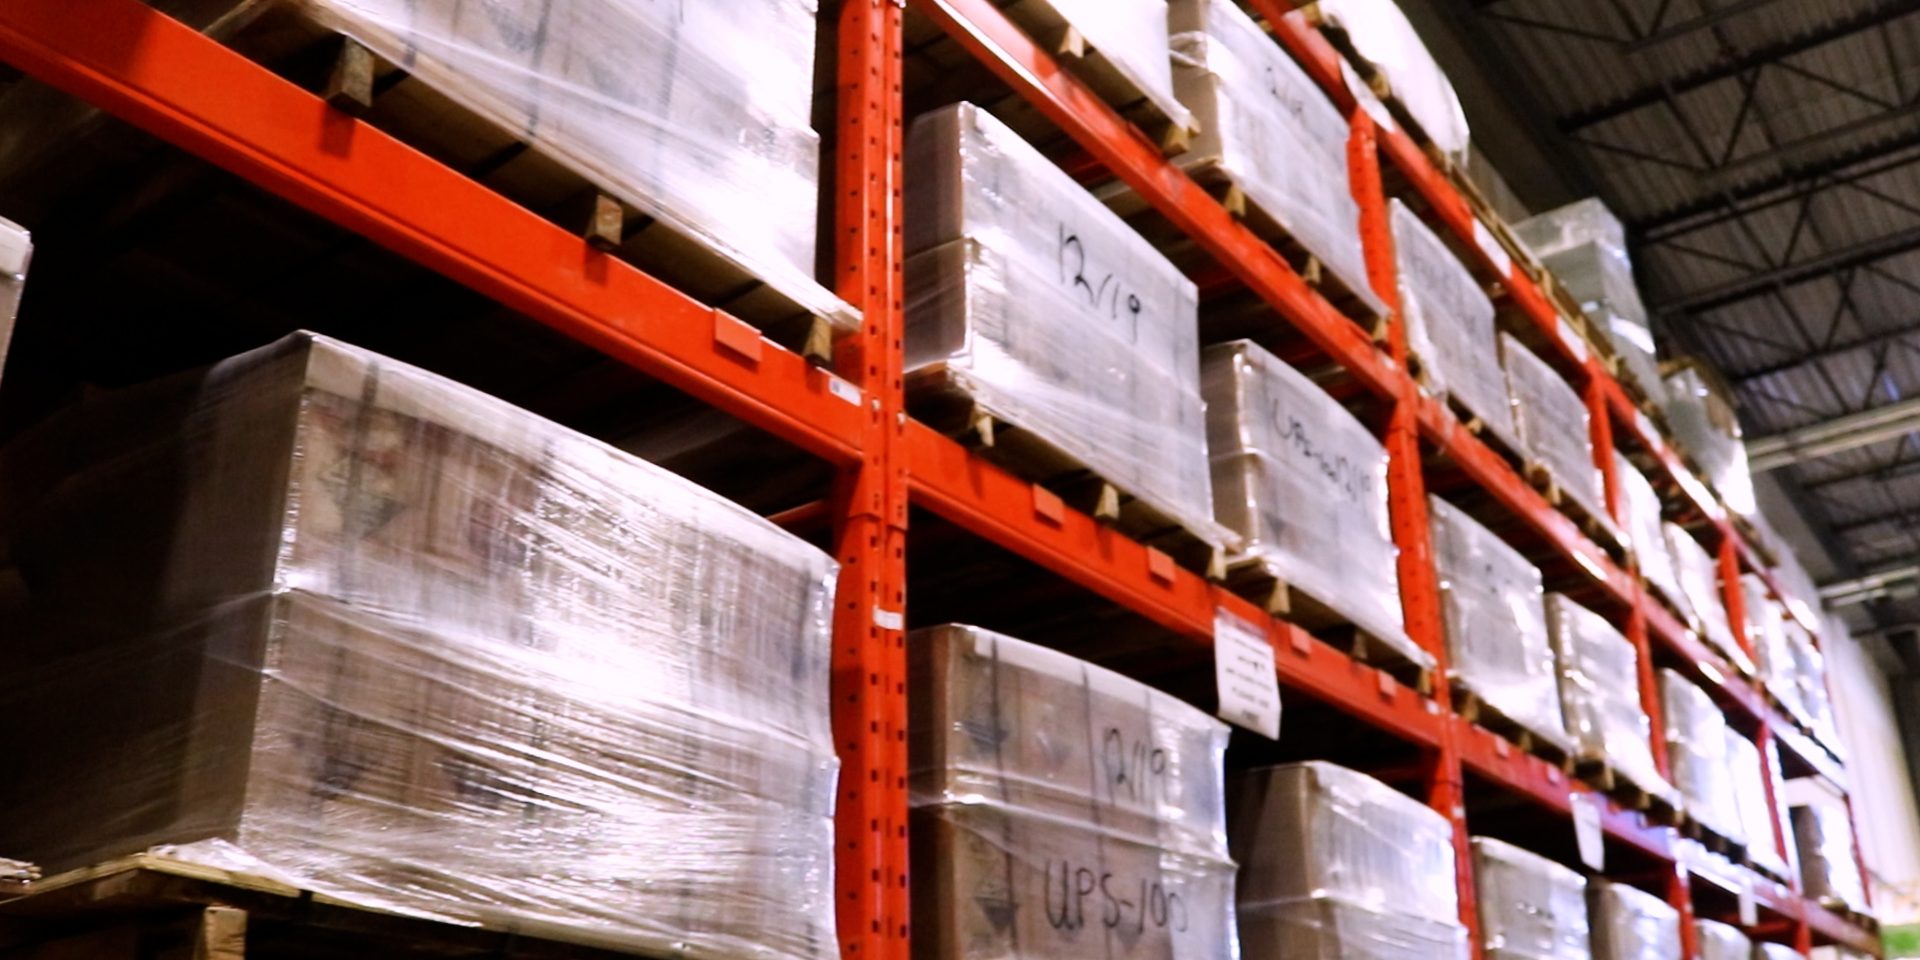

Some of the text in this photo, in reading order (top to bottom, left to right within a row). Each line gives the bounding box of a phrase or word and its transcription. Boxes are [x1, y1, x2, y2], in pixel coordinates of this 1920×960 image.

[1058, 220, 1142, 344] 12/19
[1103, 726, 1169, 808] 12/19
[1045, 859, 1189, 935] UPS-100
